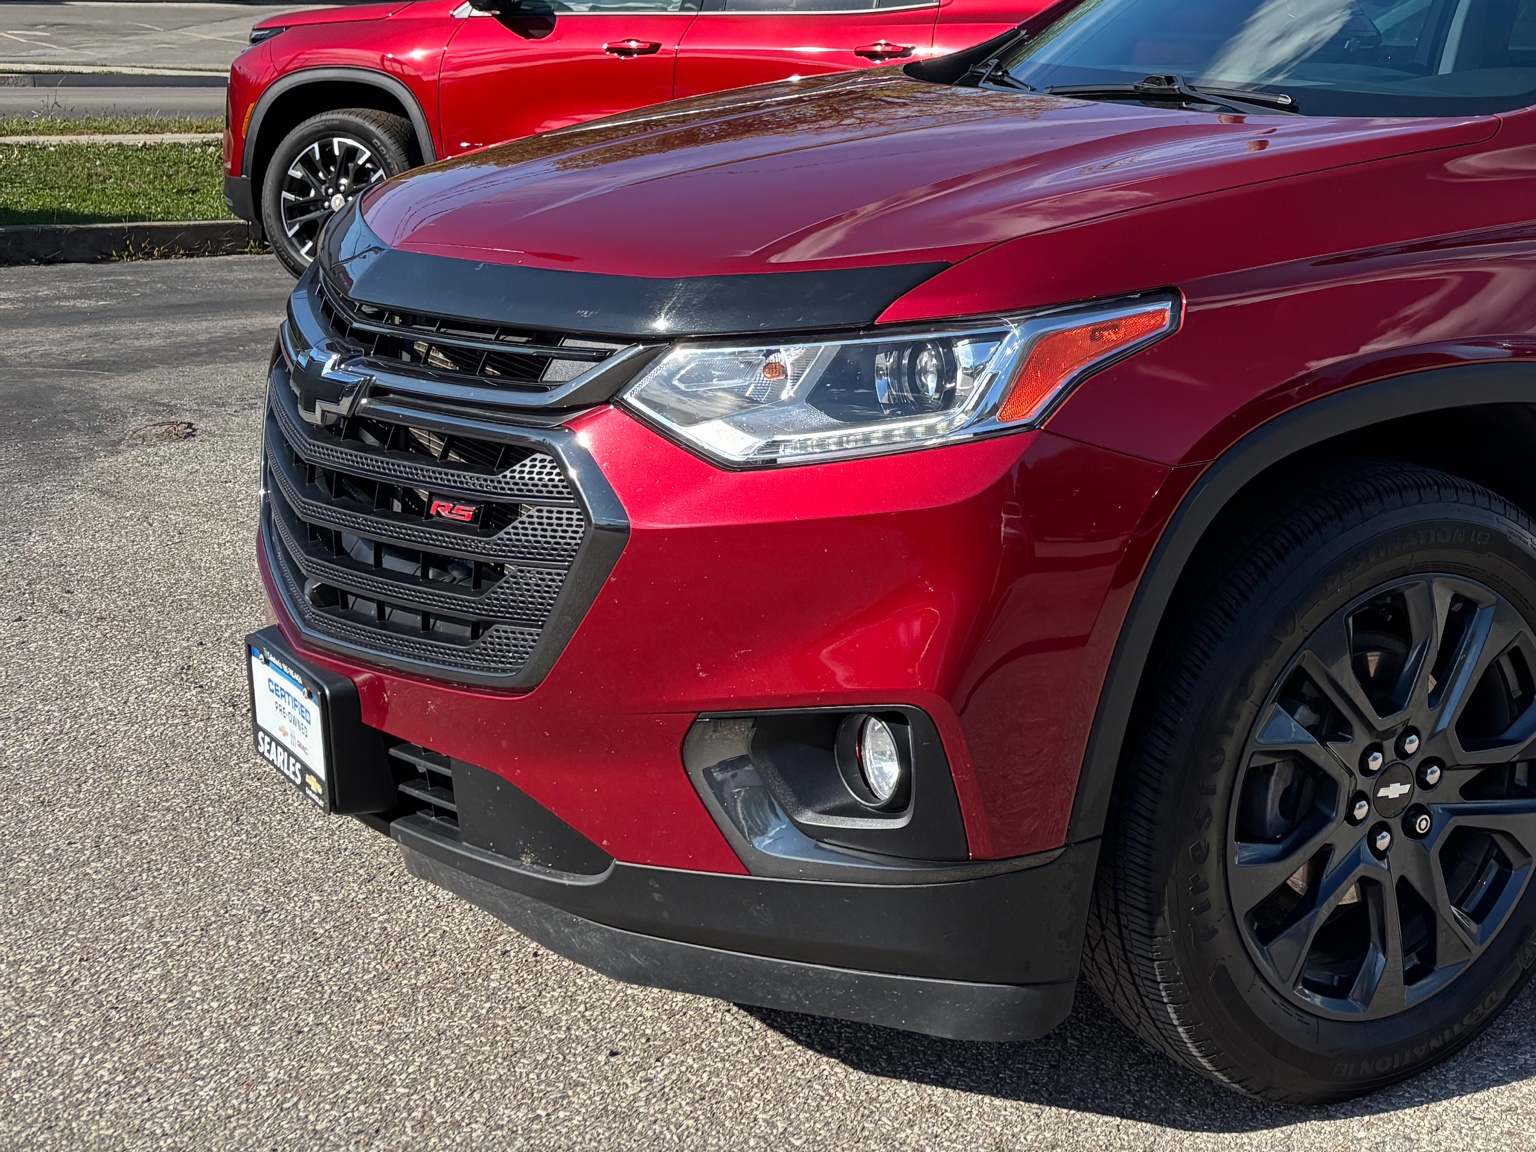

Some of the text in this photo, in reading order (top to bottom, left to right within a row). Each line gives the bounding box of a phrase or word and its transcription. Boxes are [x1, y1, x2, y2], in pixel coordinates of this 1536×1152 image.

[430, 501, 476, 522] RS
[268, 678, 311, 725] CERTIFIED
[275, 700, 308, 738] PRE-OWNED
[257, 730, 301, 785] SEARLES
